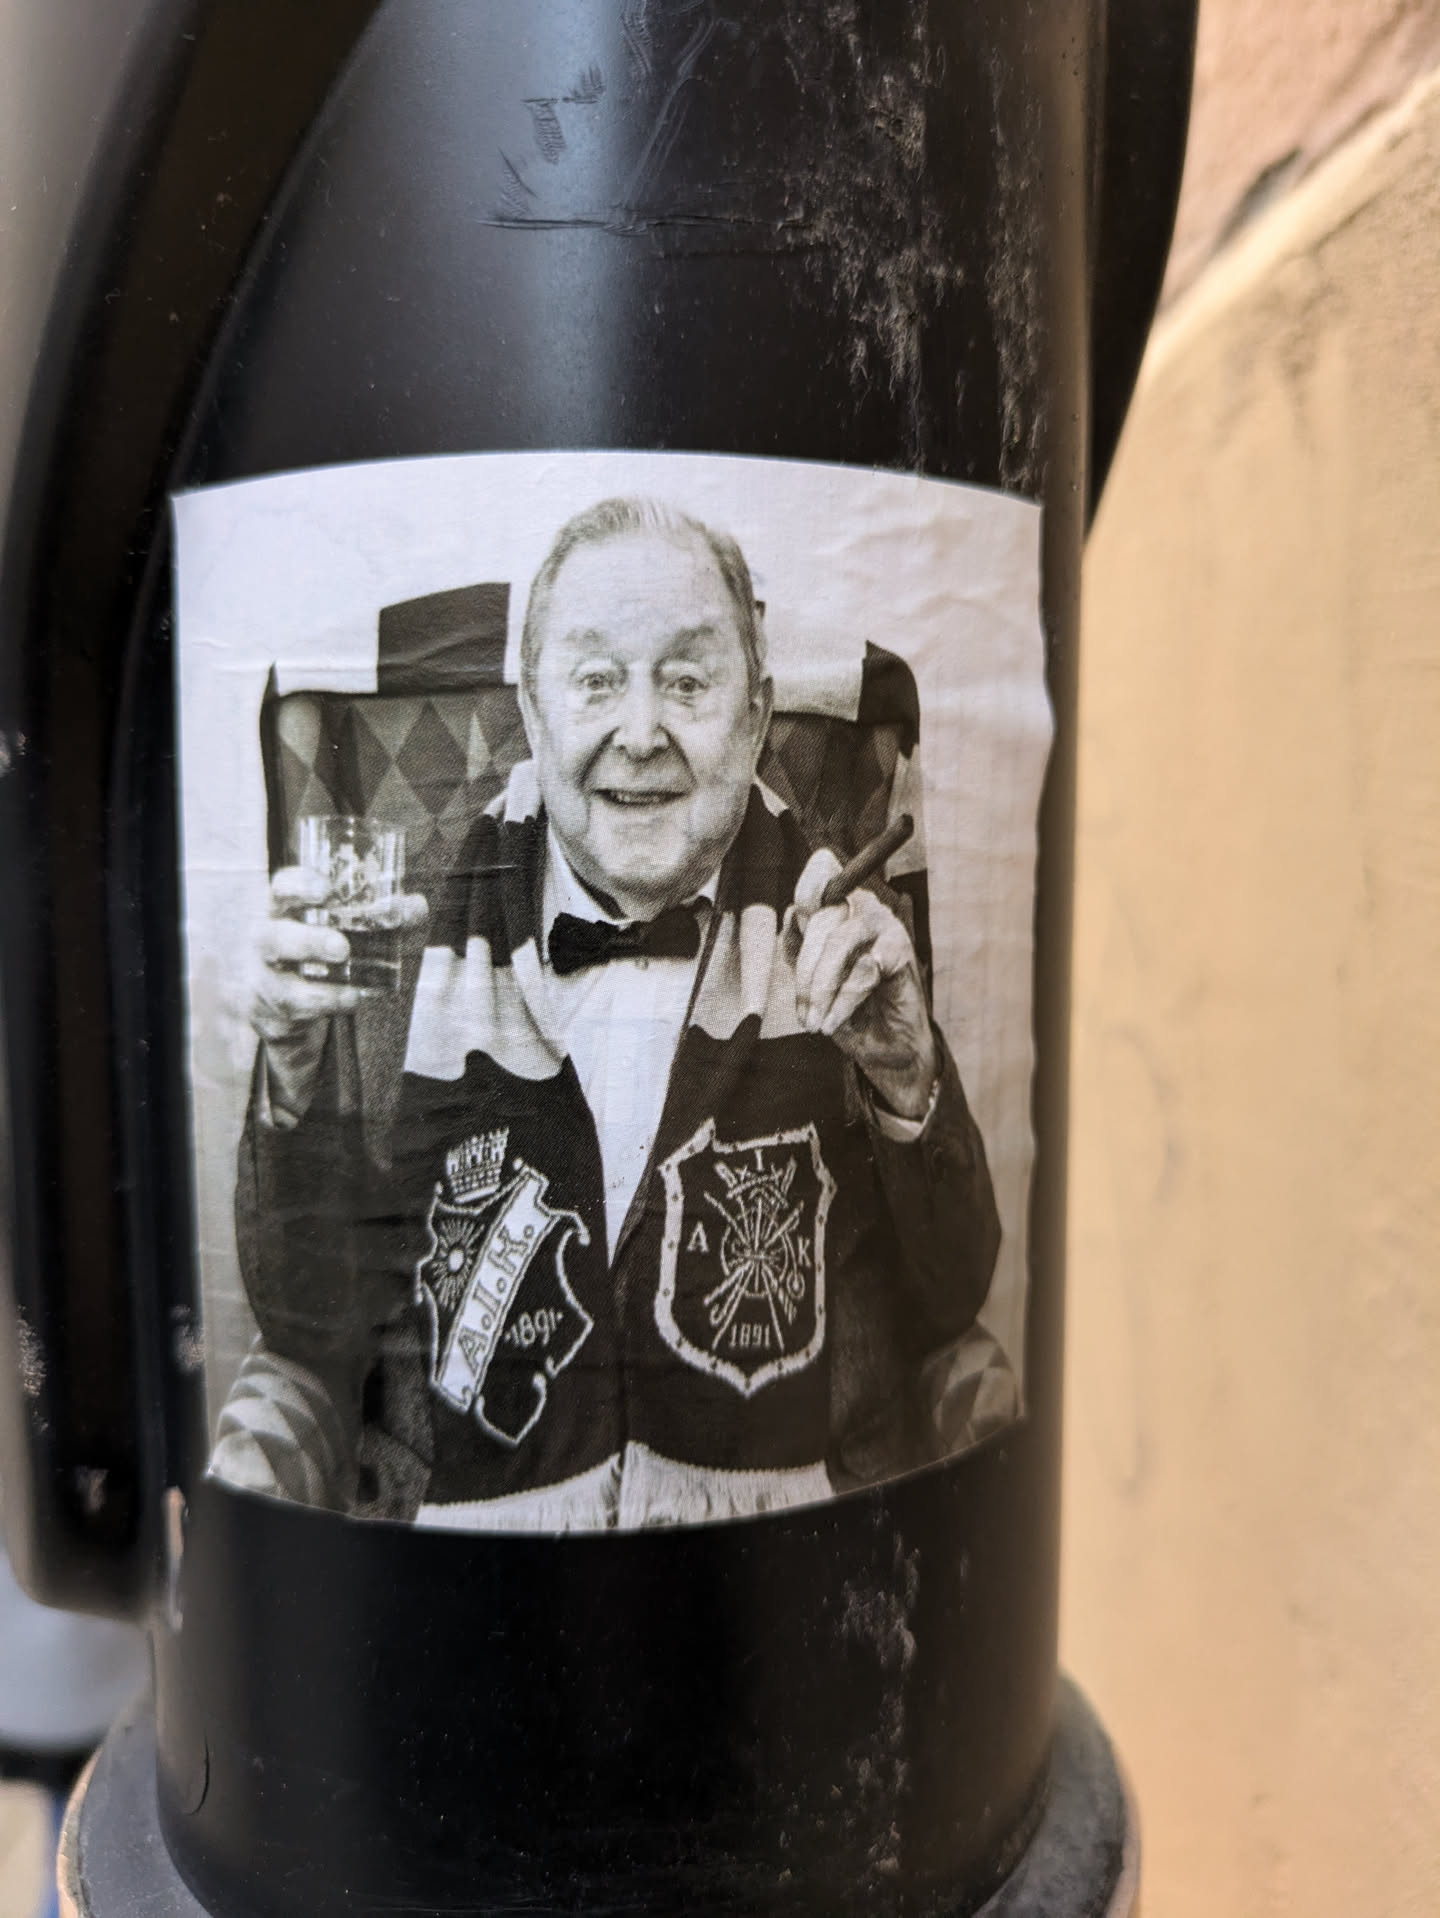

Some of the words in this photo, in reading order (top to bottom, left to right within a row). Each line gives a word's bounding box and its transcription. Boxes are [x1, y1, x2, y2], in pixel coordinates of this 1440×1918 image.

[687, 1221, 709, 1252] A
[797, 1235, 812, 1268] K
[729, 1322, 771, 1348] 1891
